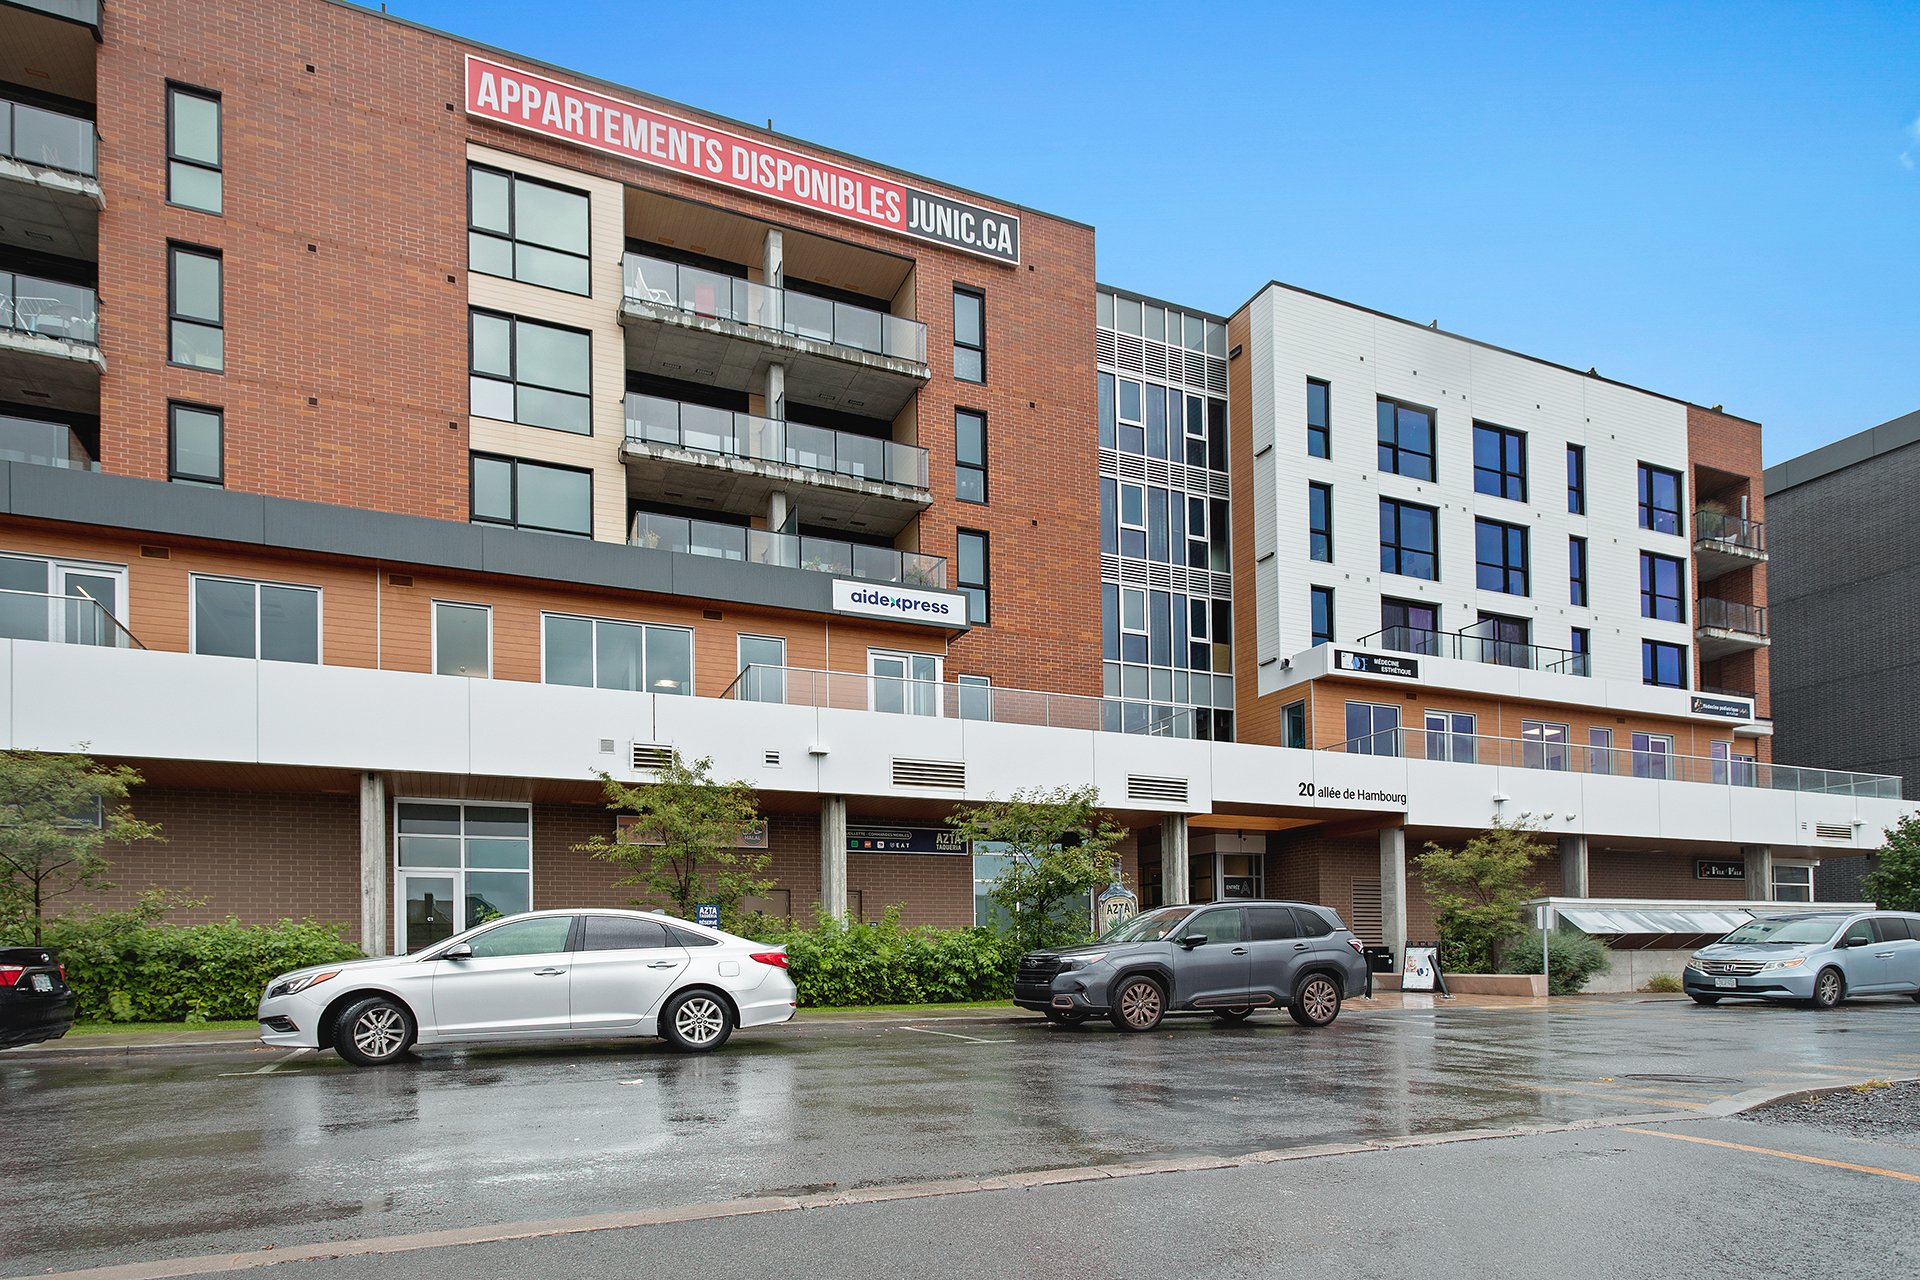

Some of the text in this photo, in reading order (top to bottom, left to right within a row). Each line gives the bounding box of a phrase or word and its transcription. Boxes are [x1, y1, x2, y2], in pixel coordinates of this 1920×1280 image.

[477, 71, 901, 224] APPARTEMENTS DISPONIBLES
[909, 198, 1013, 255] JUNIC.CA
[850, 589, 949, 614] aidexpress
[1373, 657, 1400, 667] MÉDECINE
[1381, 666, 1412, 676] ESTHÉTIQUE
[1298, 782, 1407, 805] 20 allée de Hambourg
[936, 833, 962, 845] AZTA
[1240, 881, 1250, 894] A
[699, 906, 717, 914] AZTA
[1107, 903, 1130, 914] AZTA
